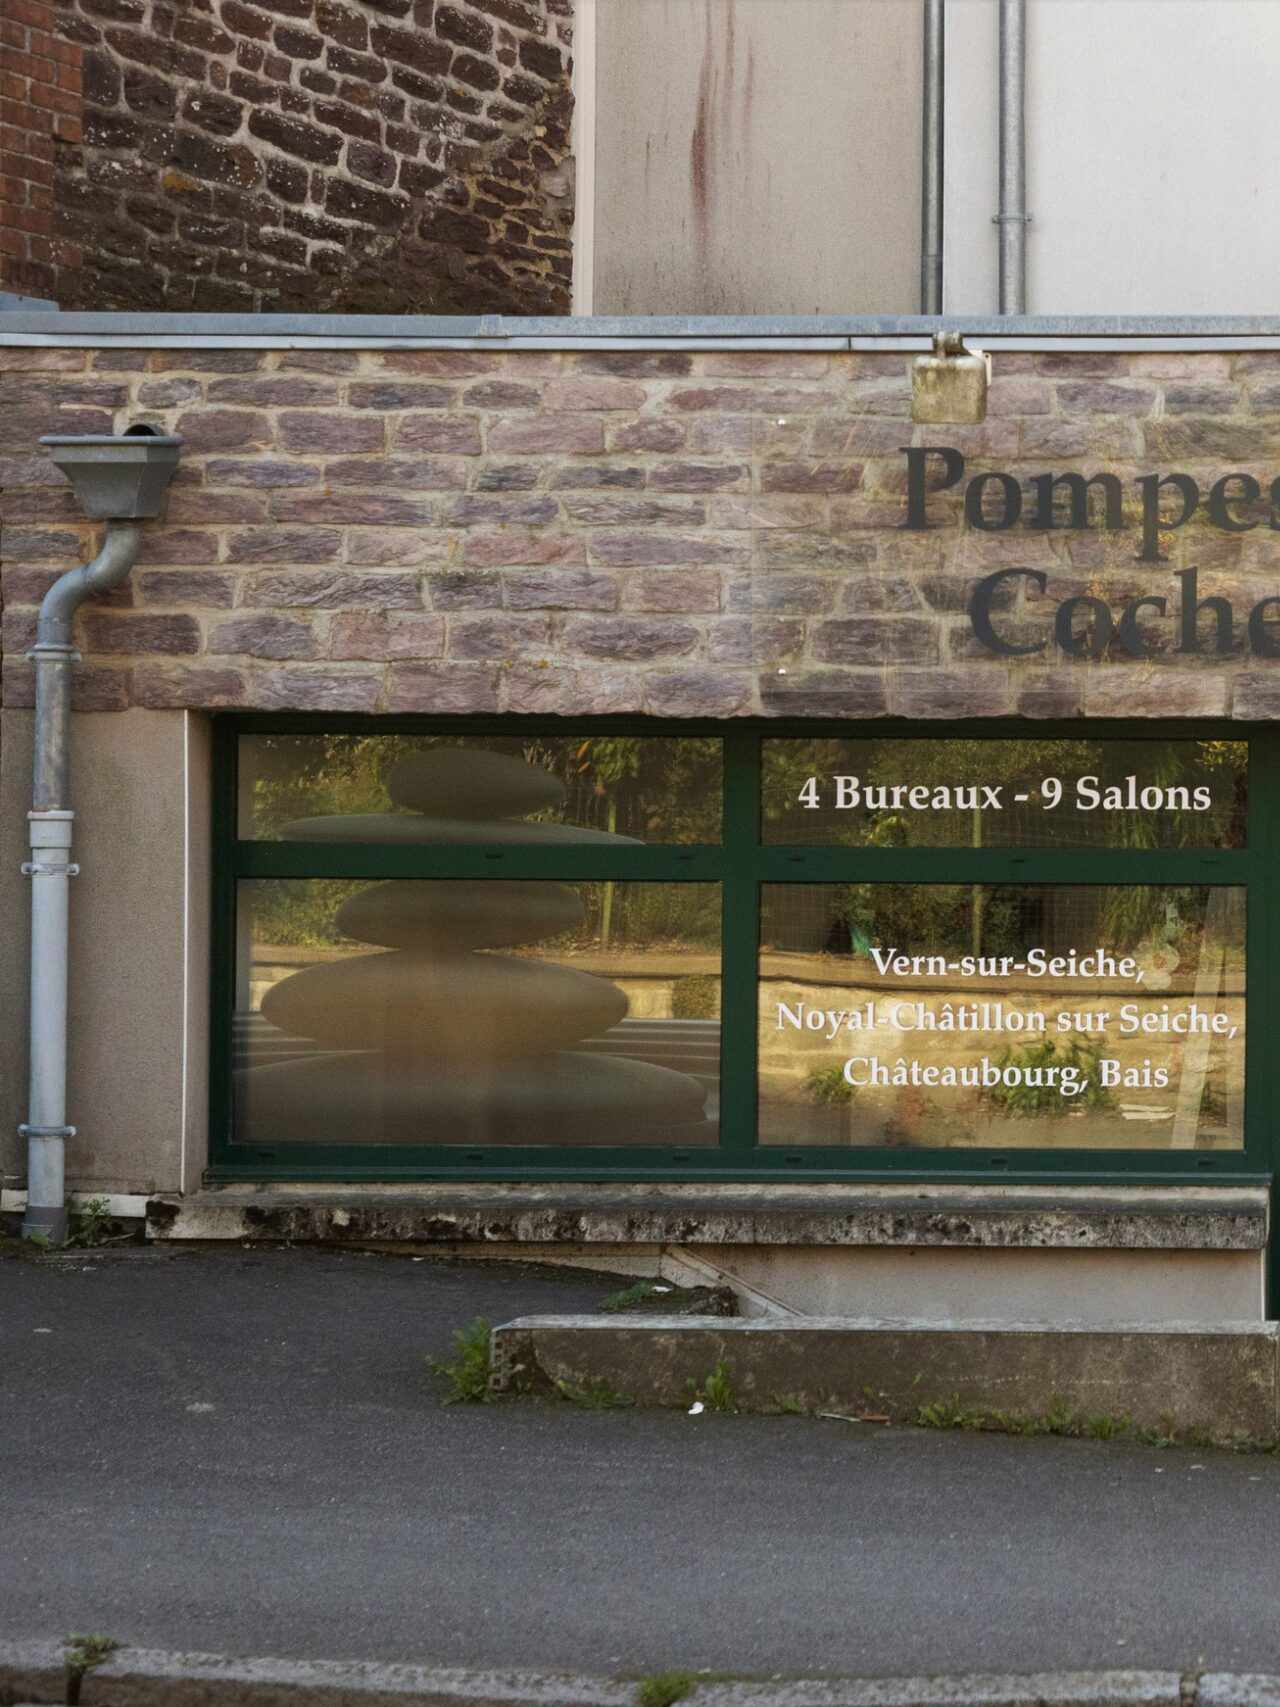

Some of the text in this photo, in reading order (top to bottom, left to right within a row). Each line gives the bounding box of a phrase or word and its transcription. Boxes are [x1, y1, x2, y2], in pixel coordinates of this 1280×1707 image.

[798, 778, 820, 809] 4
[834, 776, 1002, 809] Bureaux
[1042, 778, 1063, 809] 9
[1076, 776, 1212, 810] Salons
[870, 947, 1145, 982] Vern-sur-Seiche,
[776, 1002, 1239, 1039] Noyal-Châtillon sur Seiche,
[843, 1057, 1169, 1095] Châteaubourg, Bais
